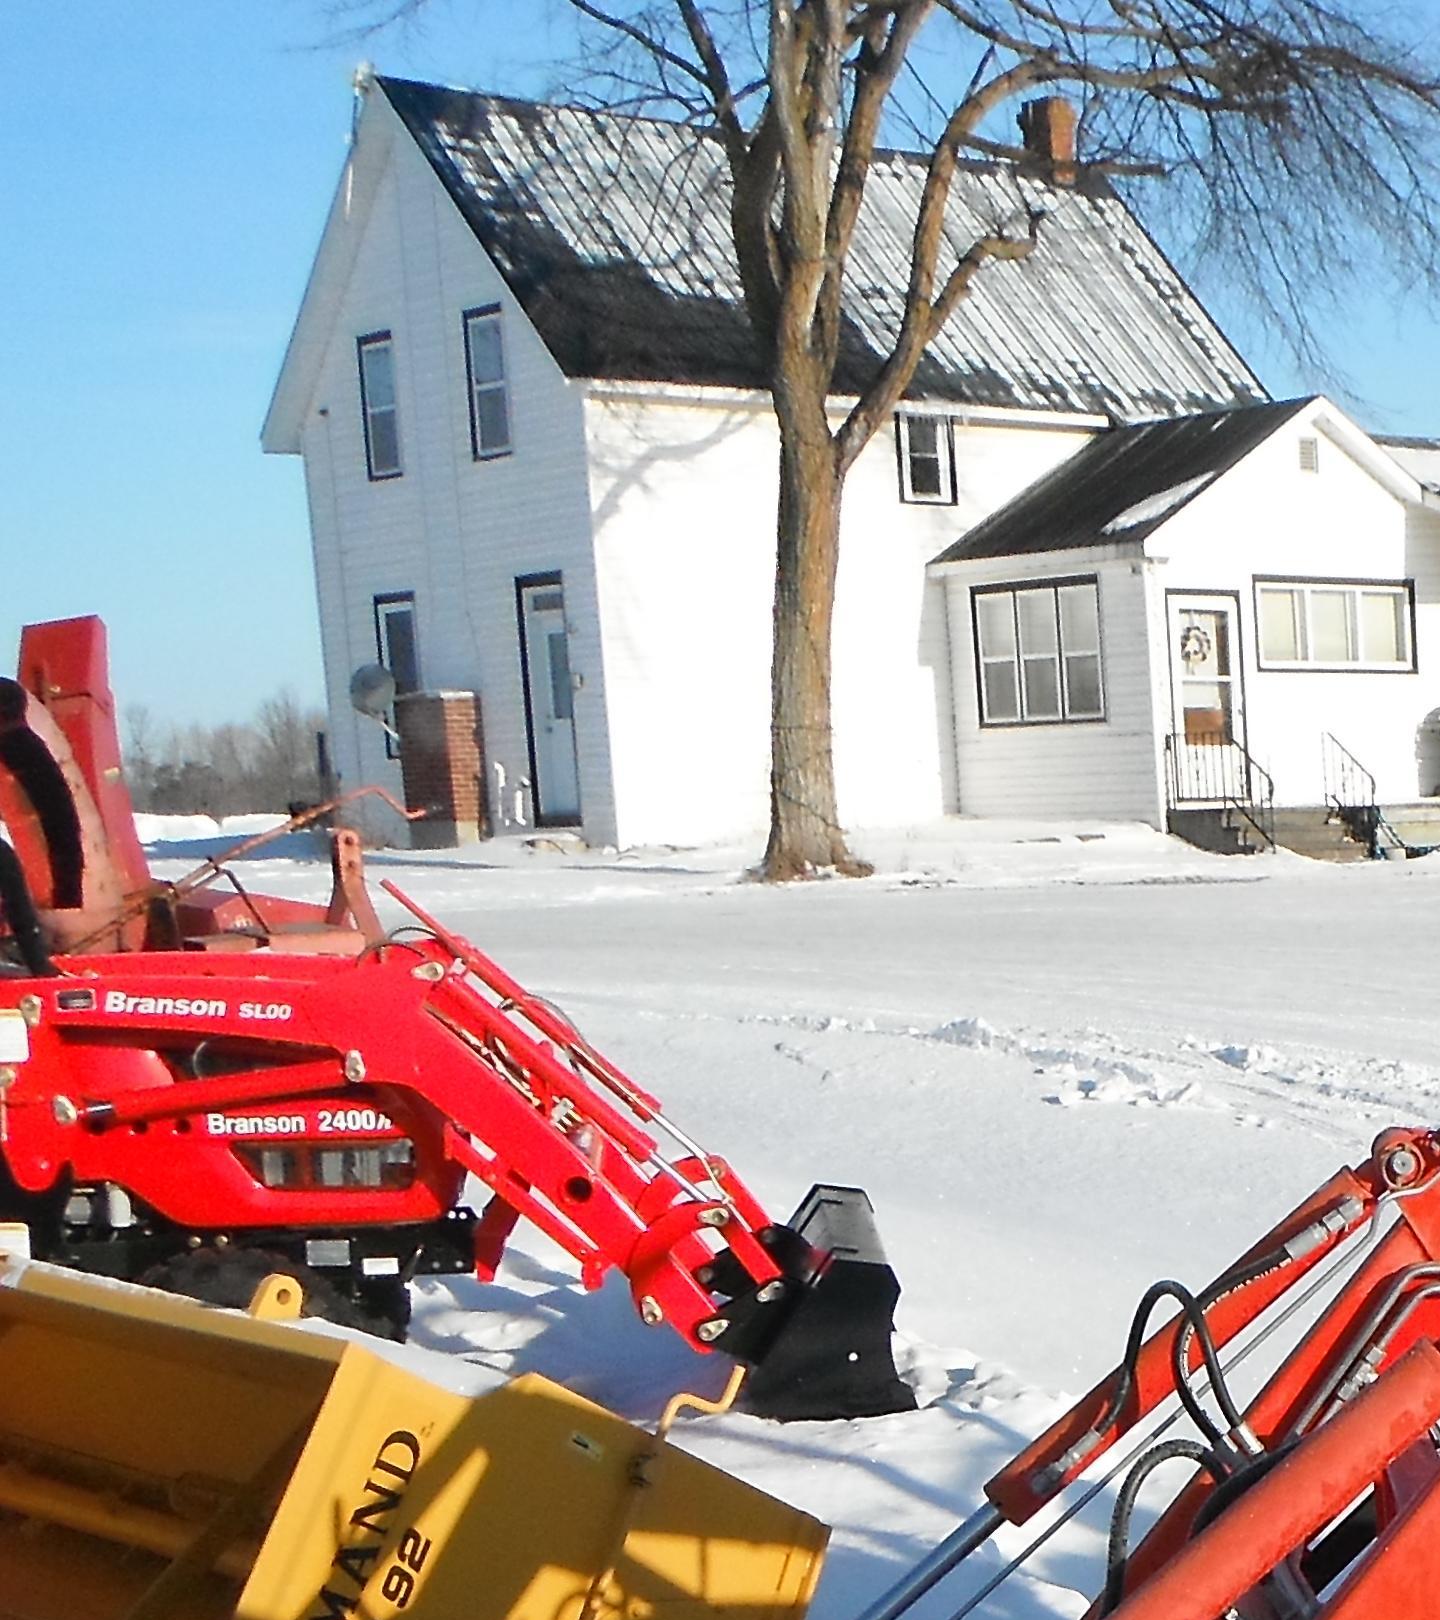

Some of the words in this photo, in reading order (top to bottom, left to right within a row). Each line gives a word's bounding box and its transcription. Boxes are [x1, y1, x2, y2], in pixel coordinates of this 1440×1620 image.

[104, 991, 227, 1018] Branson
[239, 1003, 292, 1020] SL00
[207, 1113, 305, 1134] Branson
[382, 1527, 432, 1609] 92
